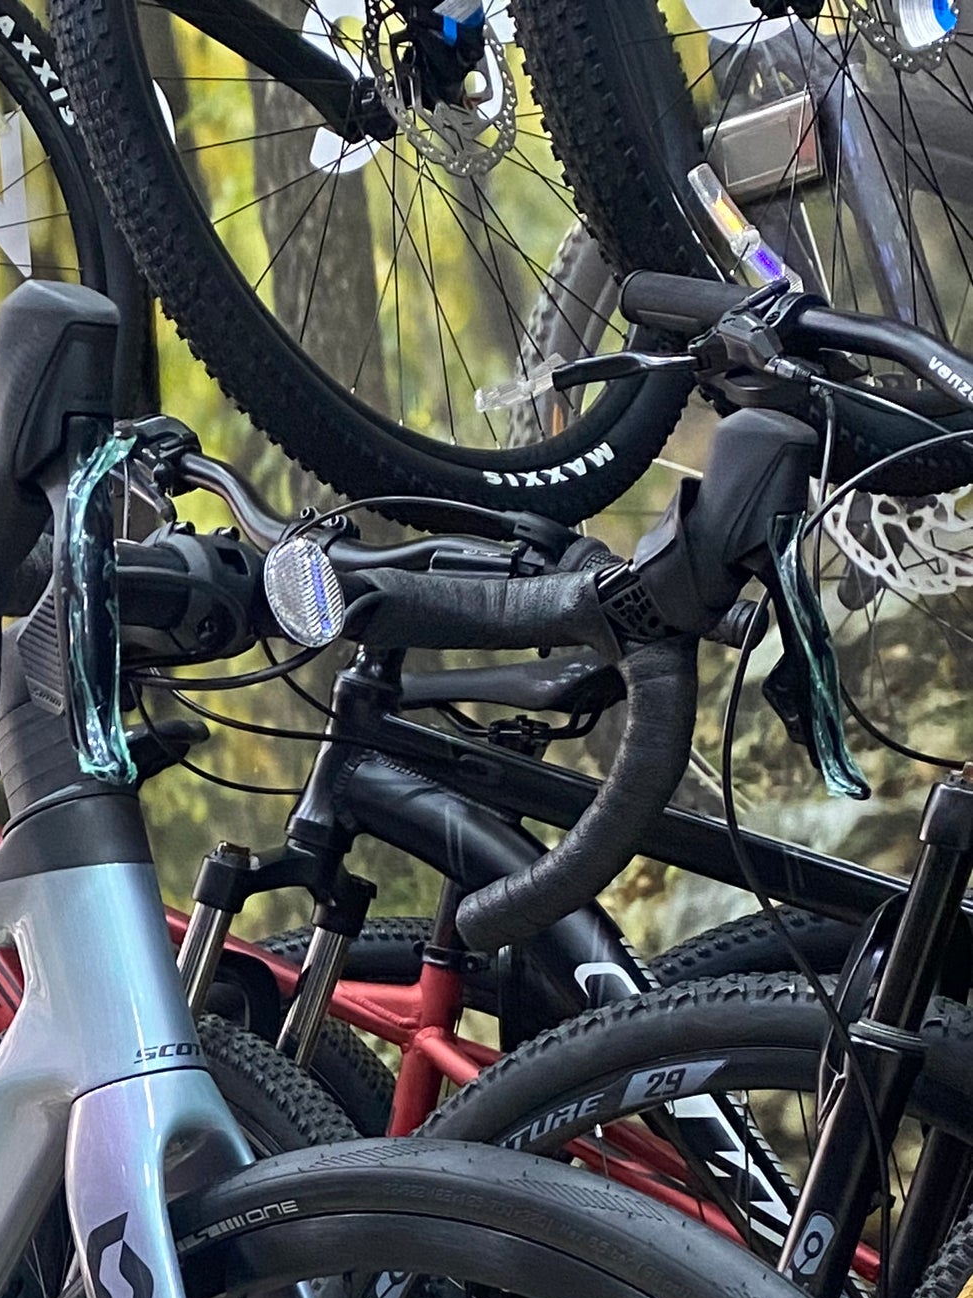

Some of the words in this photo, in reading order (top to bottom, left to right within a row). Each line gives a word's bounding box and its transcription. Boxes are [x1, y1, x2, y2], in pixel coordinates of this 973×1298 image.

[482, 442, 615, 487] MAXXIS
[643, 1068, 687, 1098] 29
[245, 1200, 299, 1224] ONE
